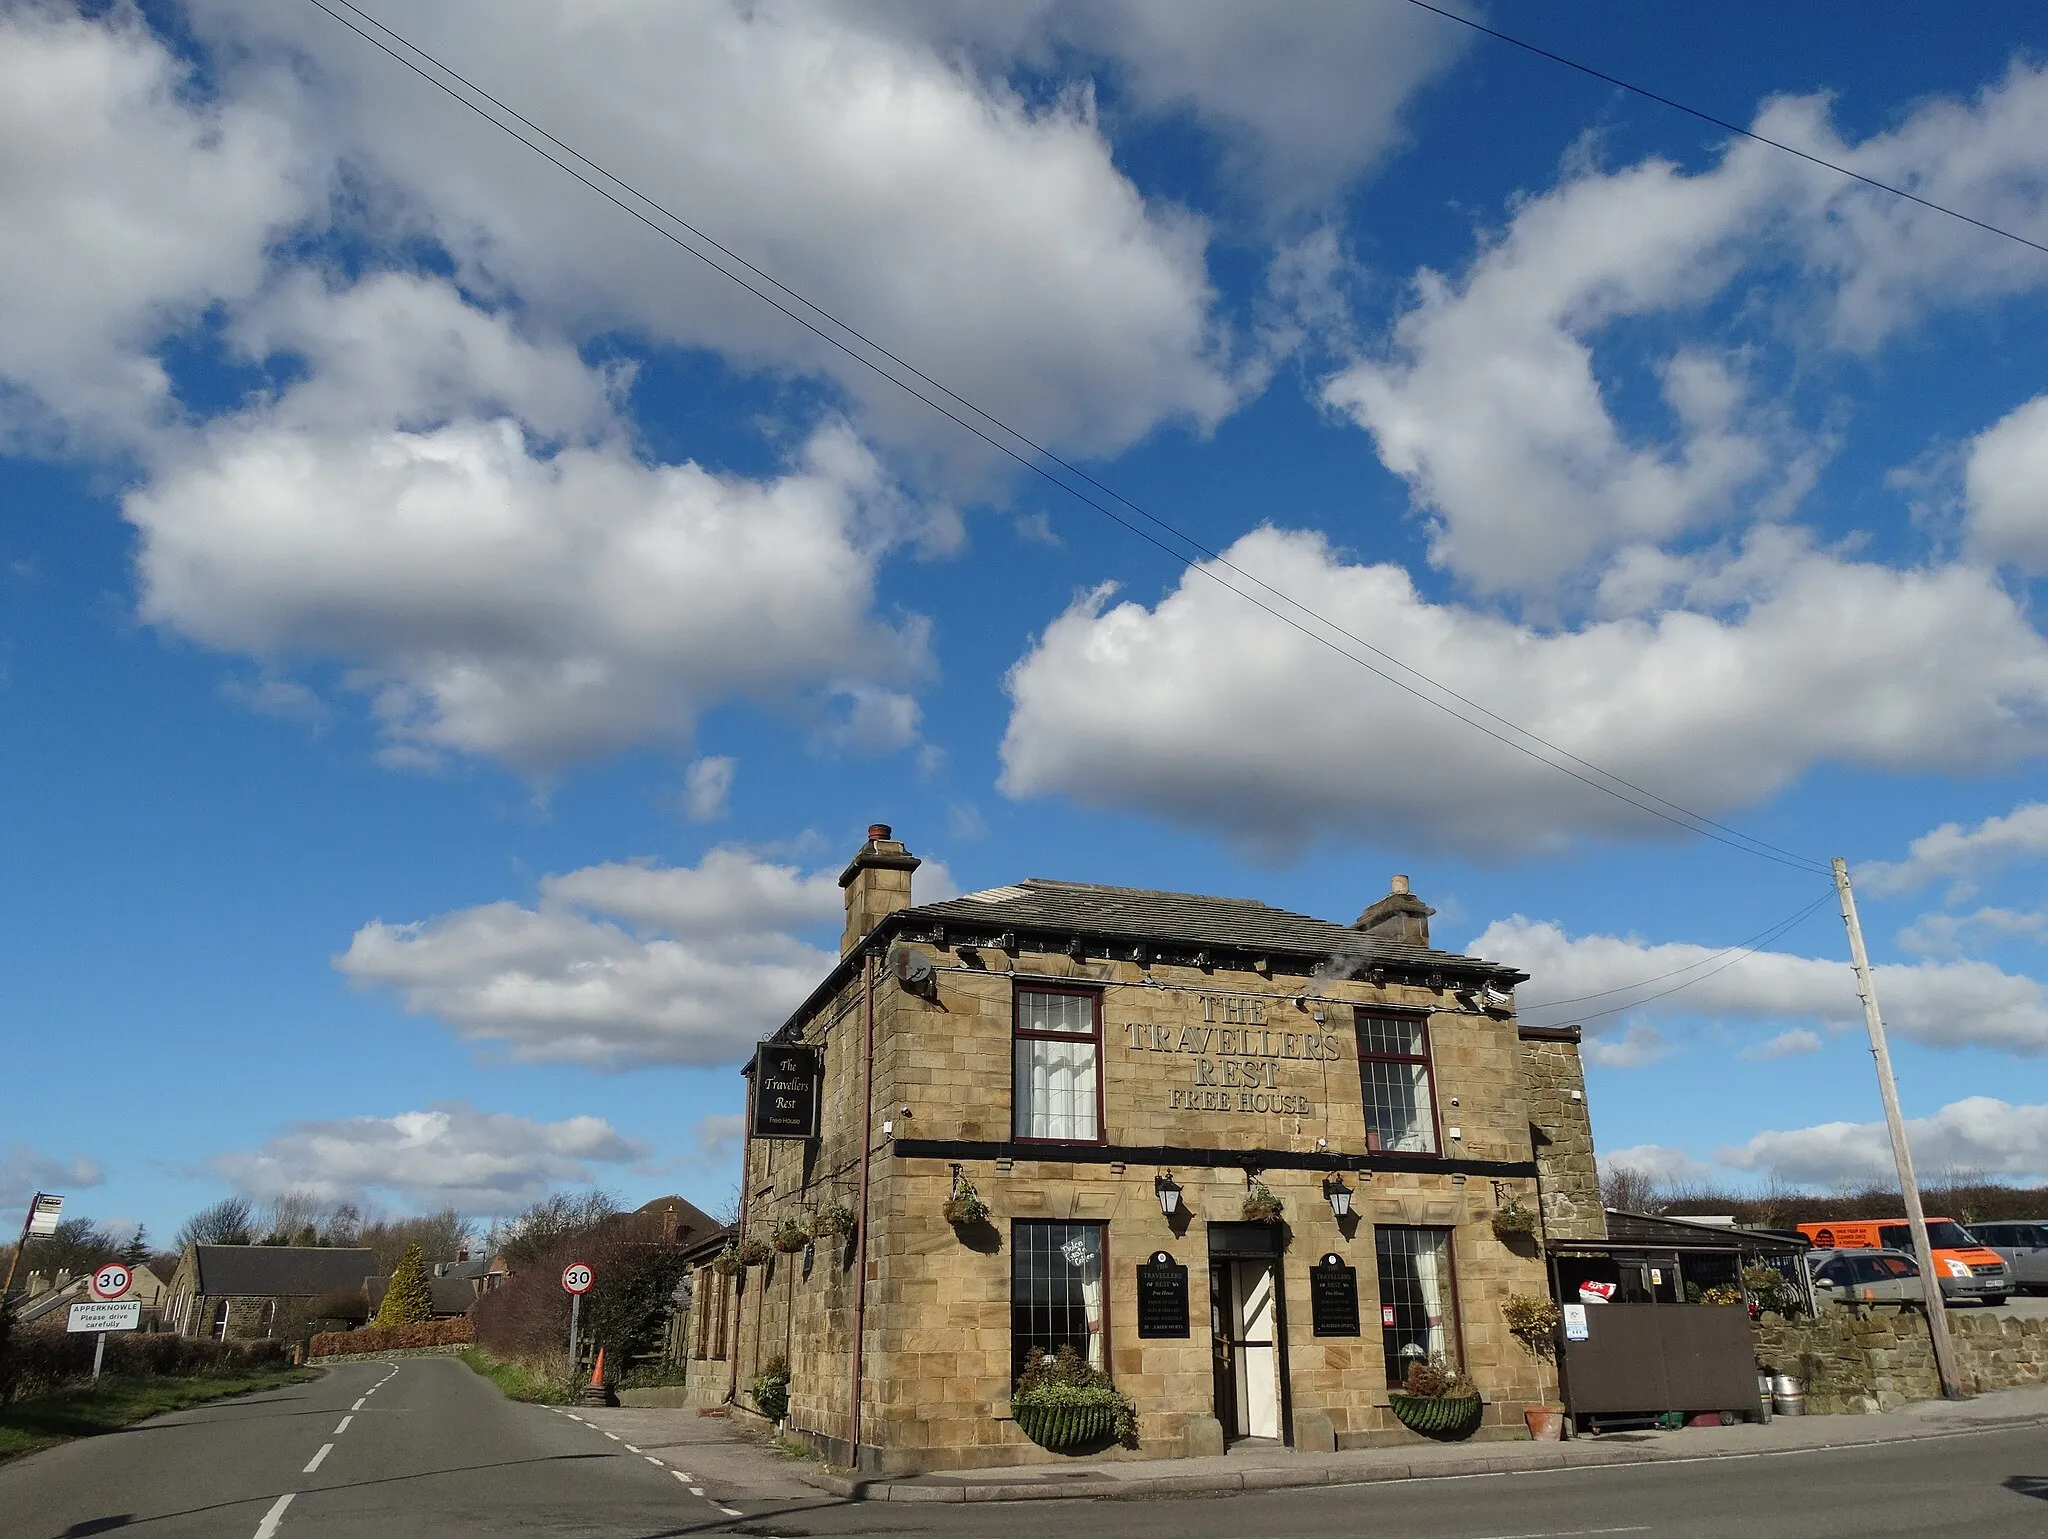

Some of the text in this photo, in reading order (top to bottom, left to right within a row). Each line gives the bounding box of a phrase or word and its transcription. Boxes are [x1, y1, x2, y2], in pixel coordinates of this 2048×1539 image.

[1199, 996, 1268, 1026] THE
[1124, 1022, 1341, 1061] TRAVELLERS
[780, 1059, 797, 1072] The
[1193, 1058, 1280, 1089] REST
[764, 1076, 809, 1092] Travellers
[775, 1097, 797, 1109] Rest
[1168, 1089, 1309, 1114] FREE HOUSE
[769, 1116, 801, 1125] Free House
[99, 1273, 126, 1287] 30
[568, 1271, 590, 1284] 30
[73, 1303, 138, 1313] APPERKNOWLE
